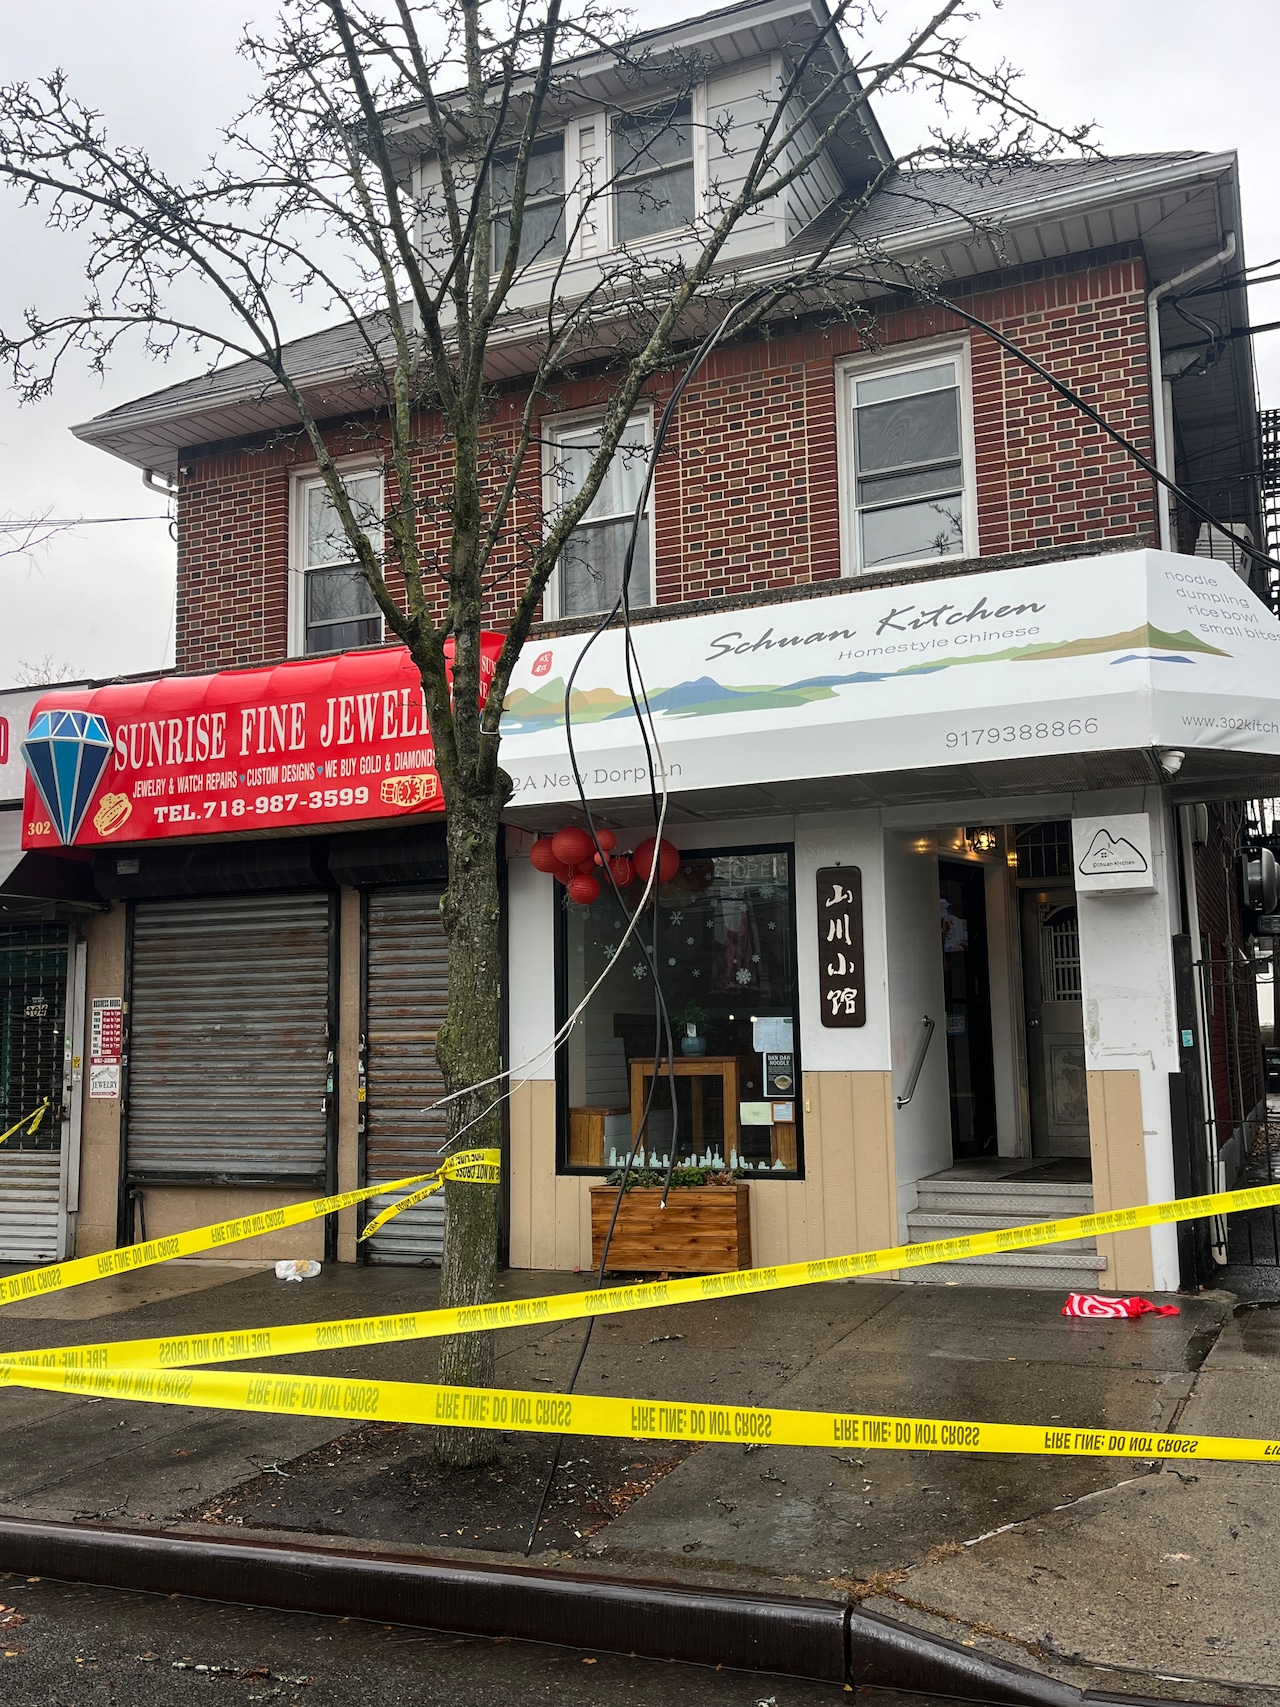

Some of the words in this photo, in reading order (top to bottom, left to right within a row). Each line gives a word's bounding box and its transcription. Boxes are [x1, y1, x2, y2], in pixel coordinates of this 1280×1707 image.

[1164, 571, 1218, 586] noodle
[1176, 588, 1250, 608] dumpling
[1188, 605, 1219, 618] rice
[1220, 609, 1259, 623] bowl
[705, 628, 857, 662] Schuan
[876, 597, 1046, 636] Kitchen
[1200, 623, 1242, 636] small
[838, 639, 948, 660] Homestyle
[954, 626, 1040, 644] Chinese
[114, 712, 226, 771] SUNRISE
[239, 702, 306, 756] FINE
[946, 718, 1098, 748] 9179388866
[132, 777, 166, 798] JEWELRY
[168, 780, 174, 794] &
[178, 774, 203, 794] WATCH
[206, 770, 238, 790] REPAIRS
[246, 766, 278, 786] CUSTOM
[282, 762, 314, 783] DESIGNS
[325, 760, 338, 778] WE
[340, 758, 357, 776] BUY
[360, 754, 382, 774] GOLD
[385, 754, 390, 772] &
[543, 772, 588, 789] New
[594, 768, 646, 784] Dorp
[654, 763, 682, 778] Ln
[28, 821, 50, 836] 302
